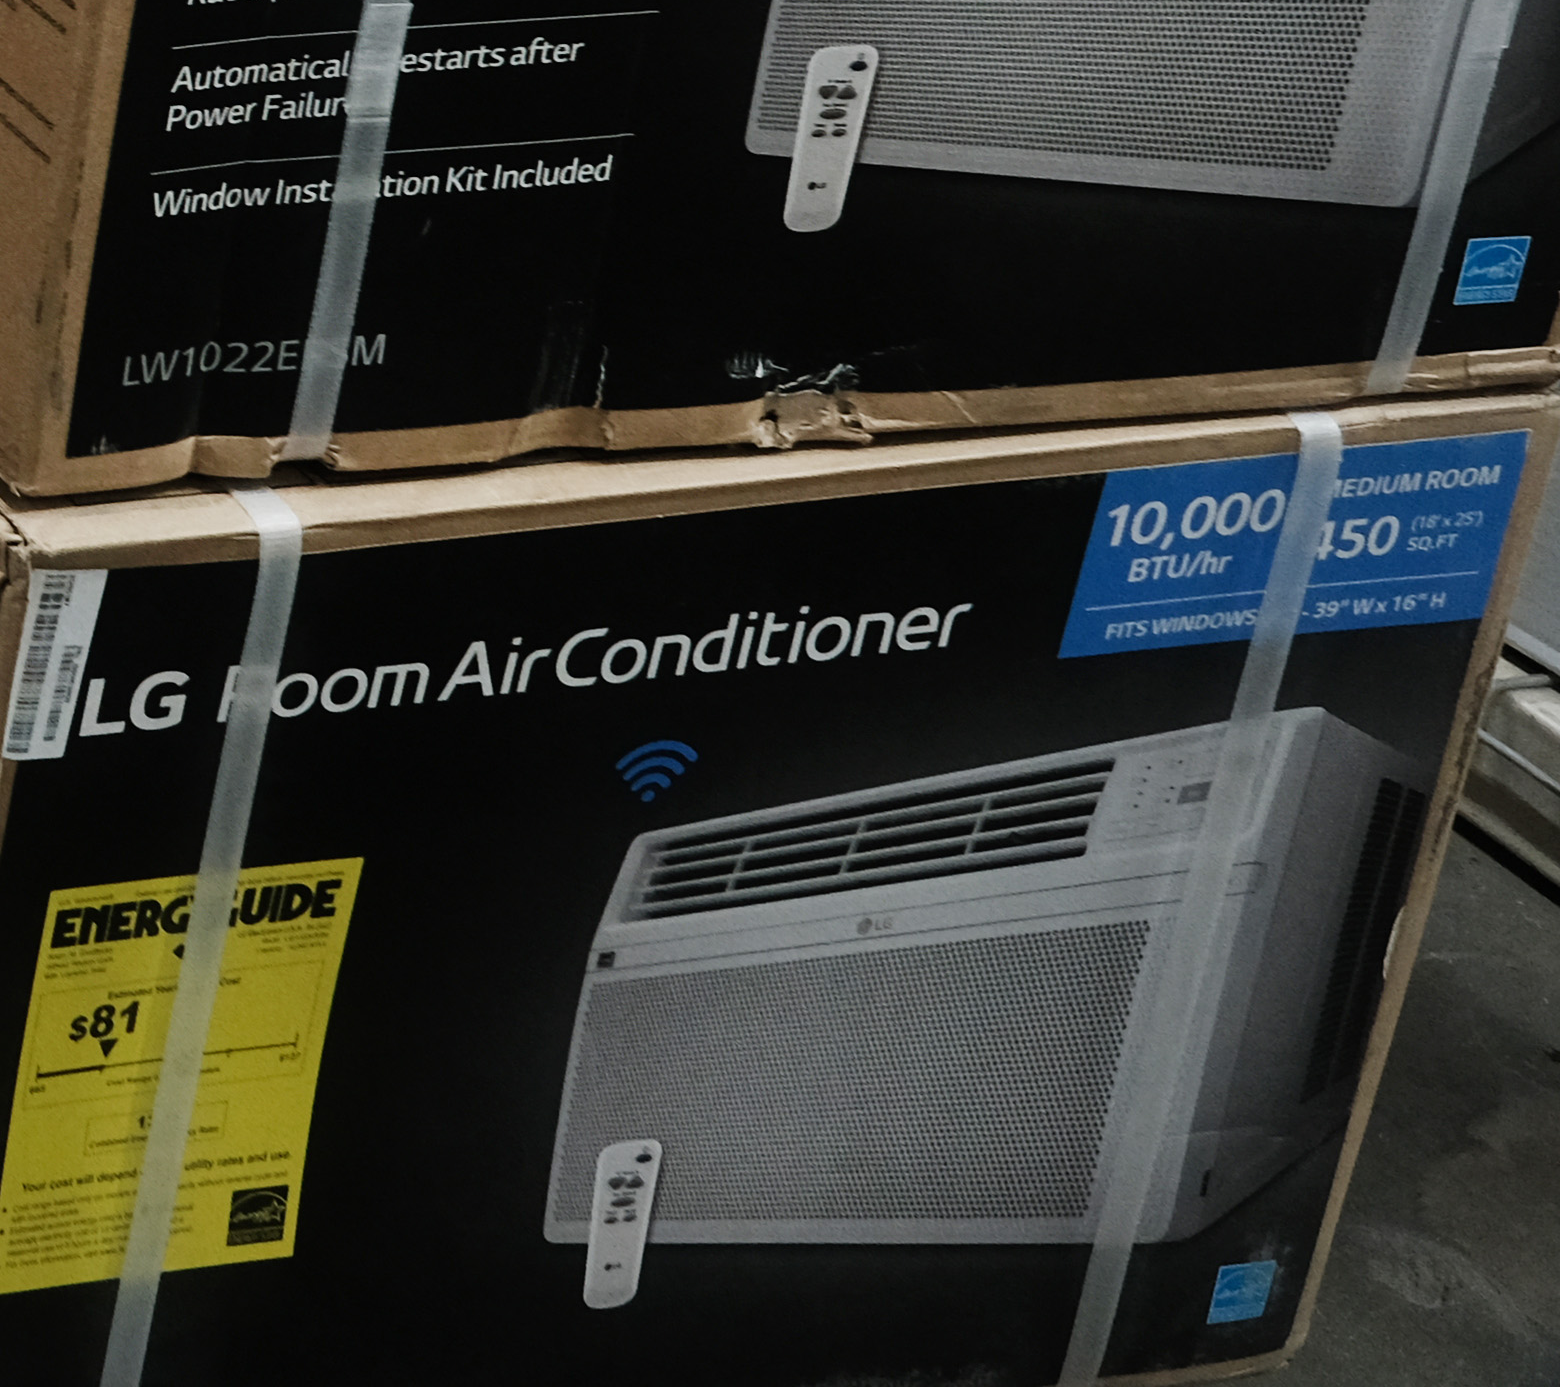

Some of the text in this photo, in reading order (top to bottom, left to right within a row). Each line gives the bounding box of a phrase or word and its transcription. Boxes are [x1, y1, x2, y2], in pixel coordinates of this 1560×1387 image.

[164, 98, 257, 133] Power
[151, 155, 614, 219] Window Included
[1424, 465, 1501, 490] ROOM
[1107, 488, 1287, 551] 10,000
[1127, 550, 1233, 583] BTU/hr
[76, 669, 190, 739] LG
[68, 1000, 141, 1043] $81
